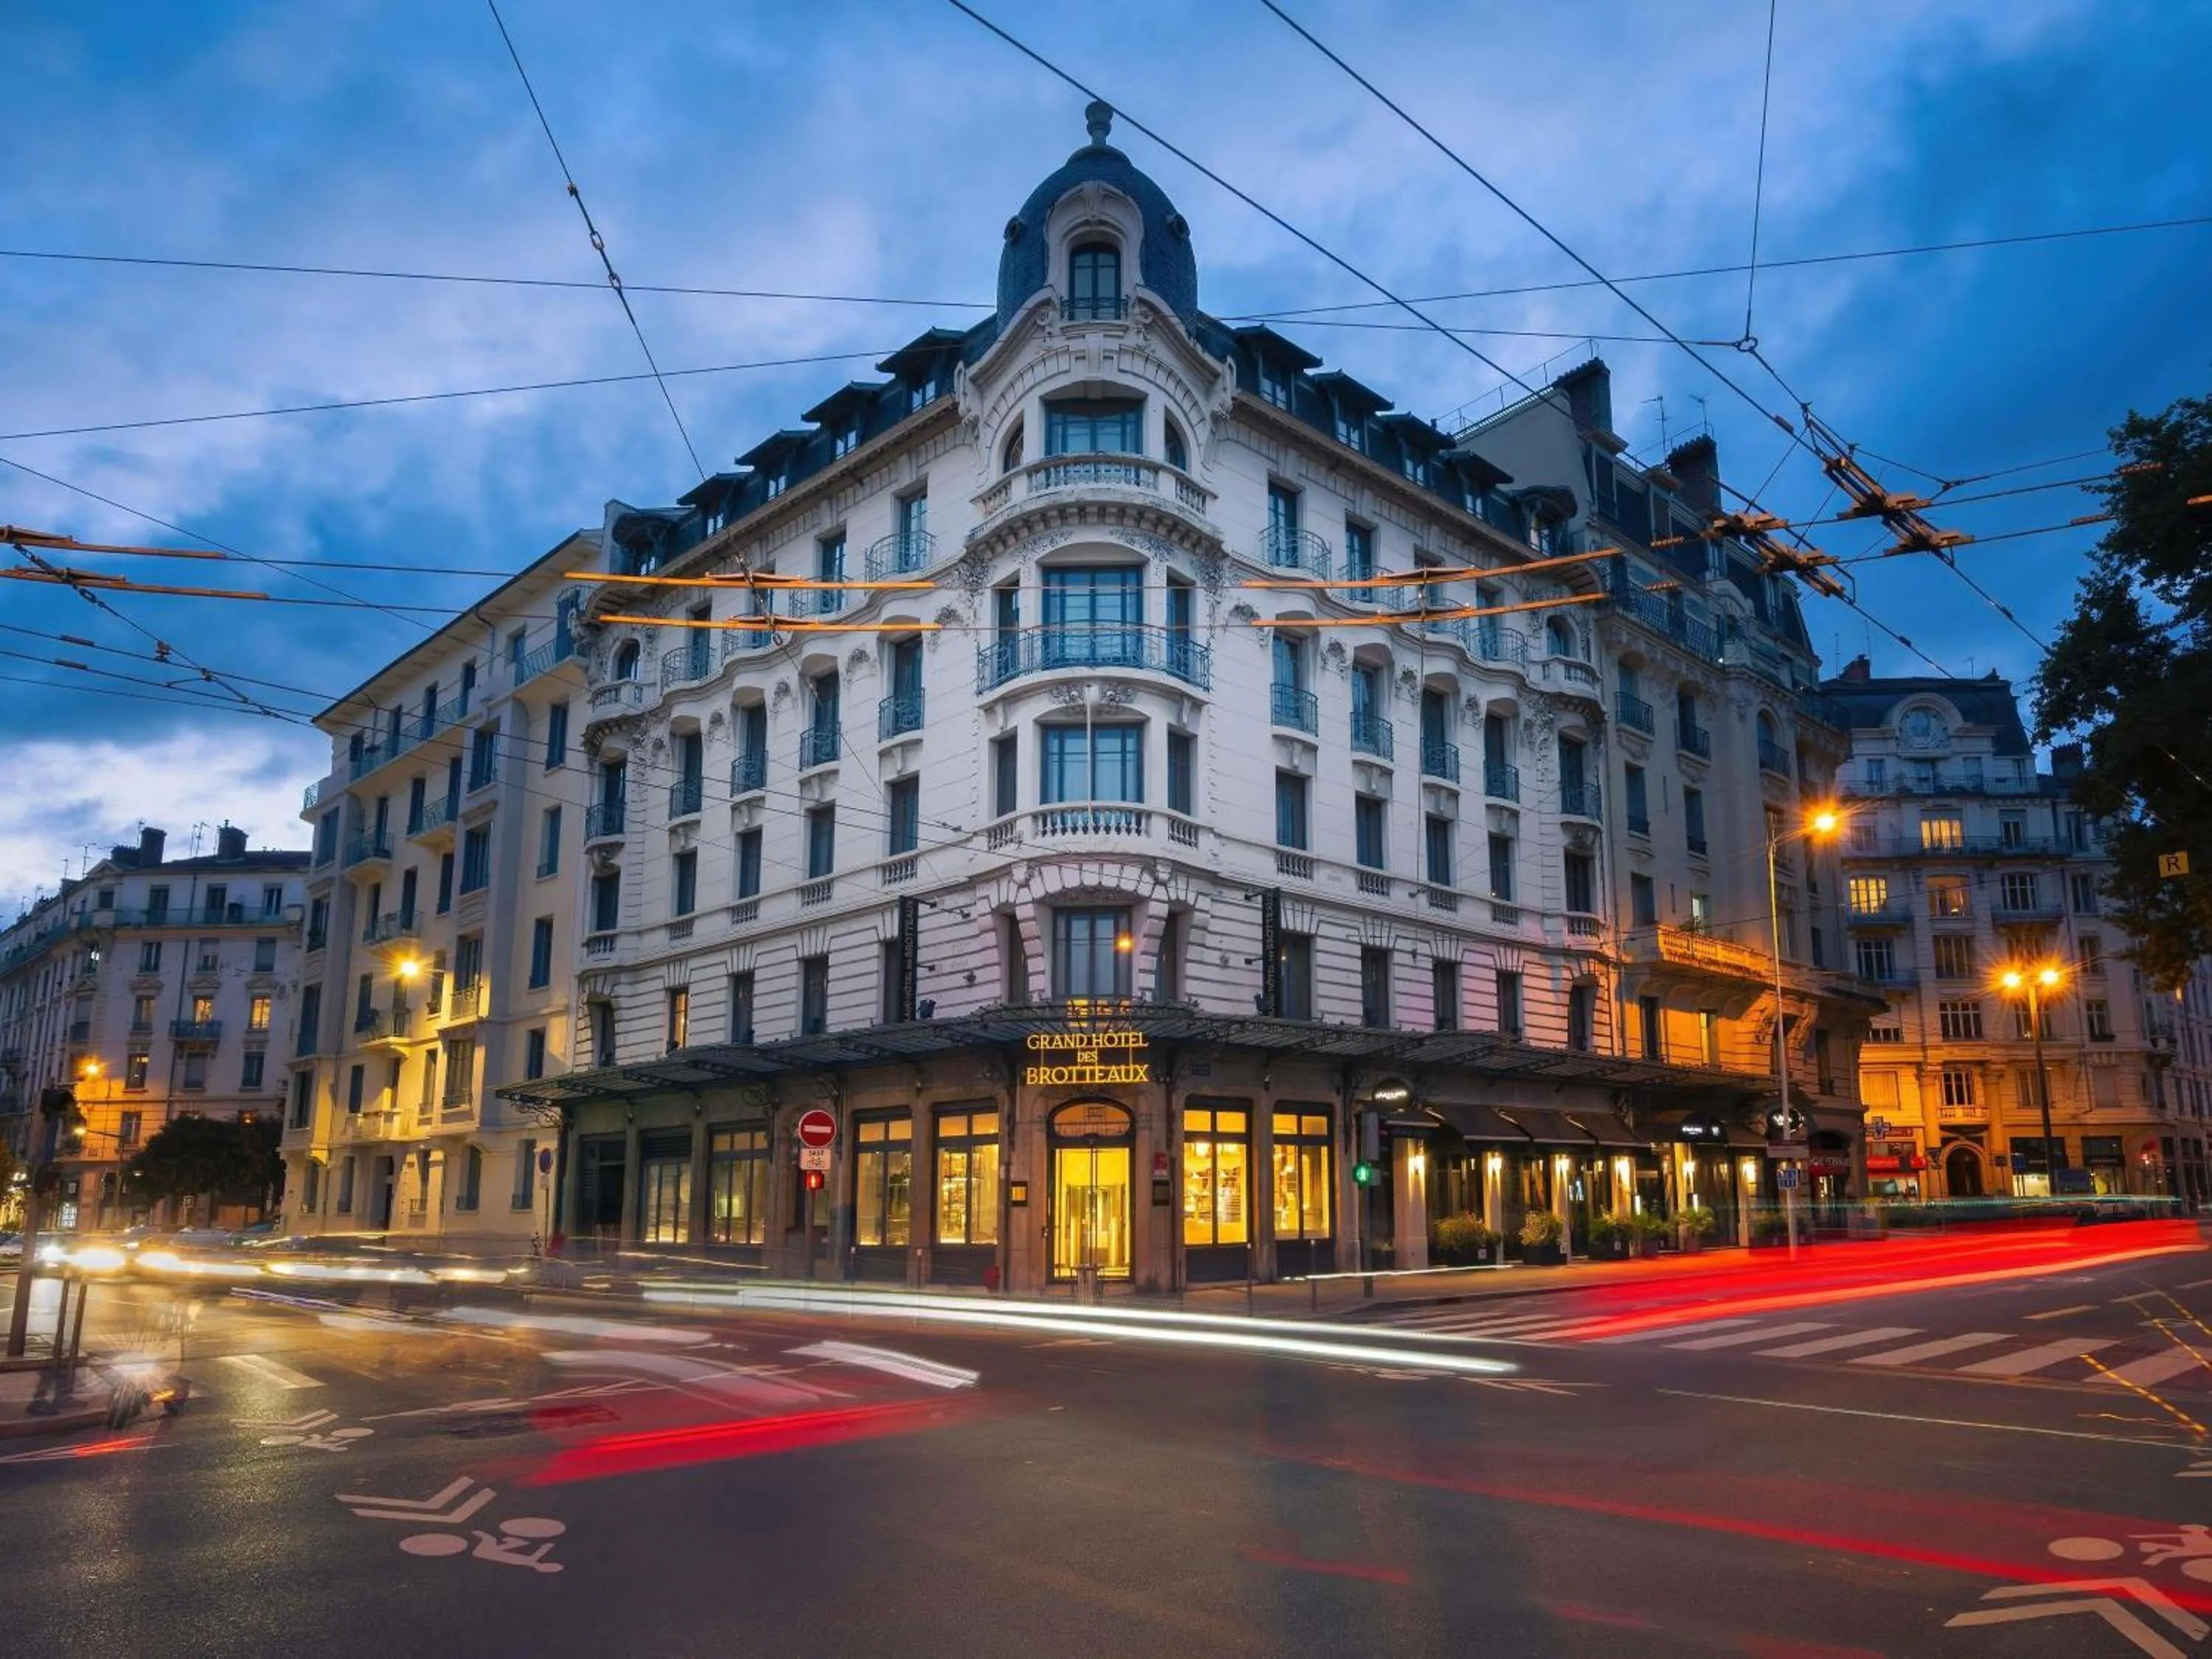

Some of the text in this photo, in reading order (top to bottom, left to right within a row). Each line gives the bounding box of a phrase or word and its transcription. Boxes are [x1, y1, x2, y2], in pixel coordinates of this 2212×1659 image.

[2166, 856, 2181, 872] R
[1027, 1029, 1149, 1048] GRAND HÔTEL
[1077, 1051, 1098, 1062] DES
[1026, 1065, 1149, 1085] BROTTEAUX
